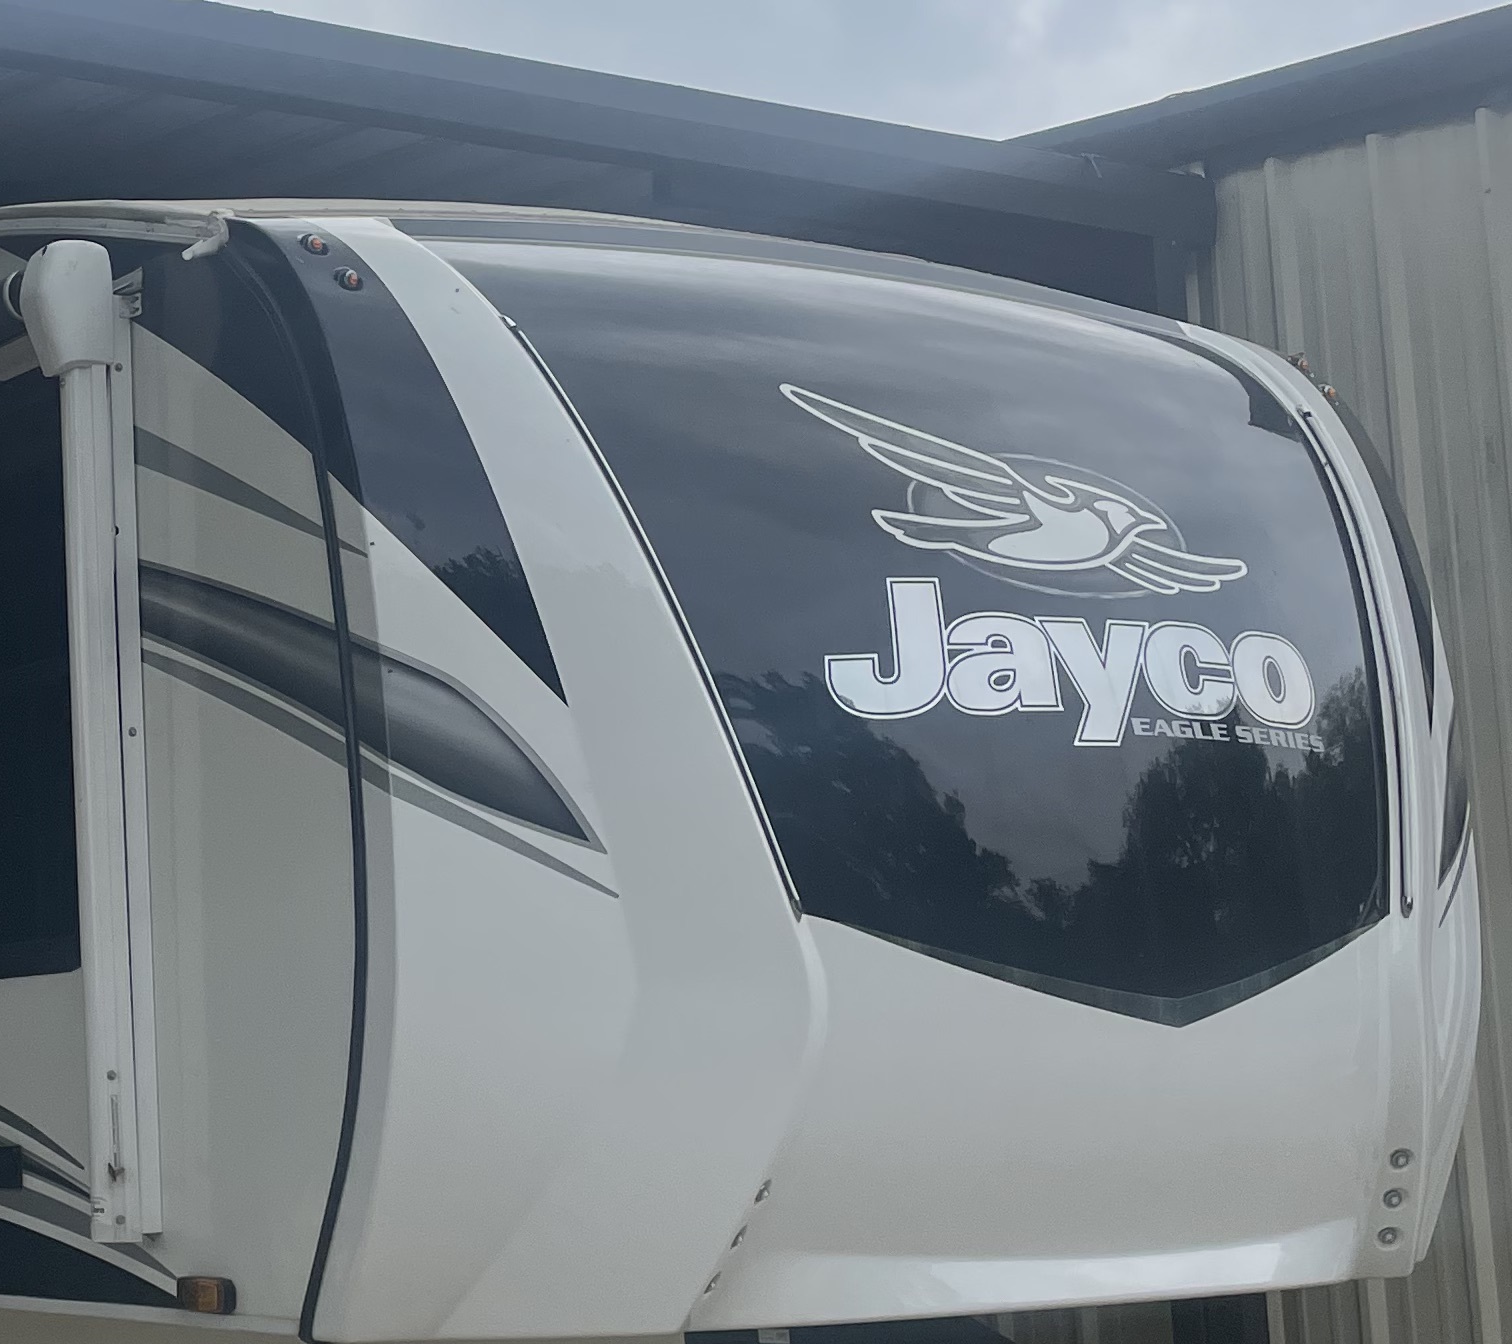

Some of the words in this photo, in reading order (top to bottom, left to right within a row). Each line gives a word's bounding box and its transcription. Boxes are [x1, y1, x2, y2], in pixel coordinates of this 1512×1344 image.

[825, 577, 1316, 747] Jayco
[1130, 716, 1232, 742] EAGLE
[1234, 724, 1325, 753] SERIES
